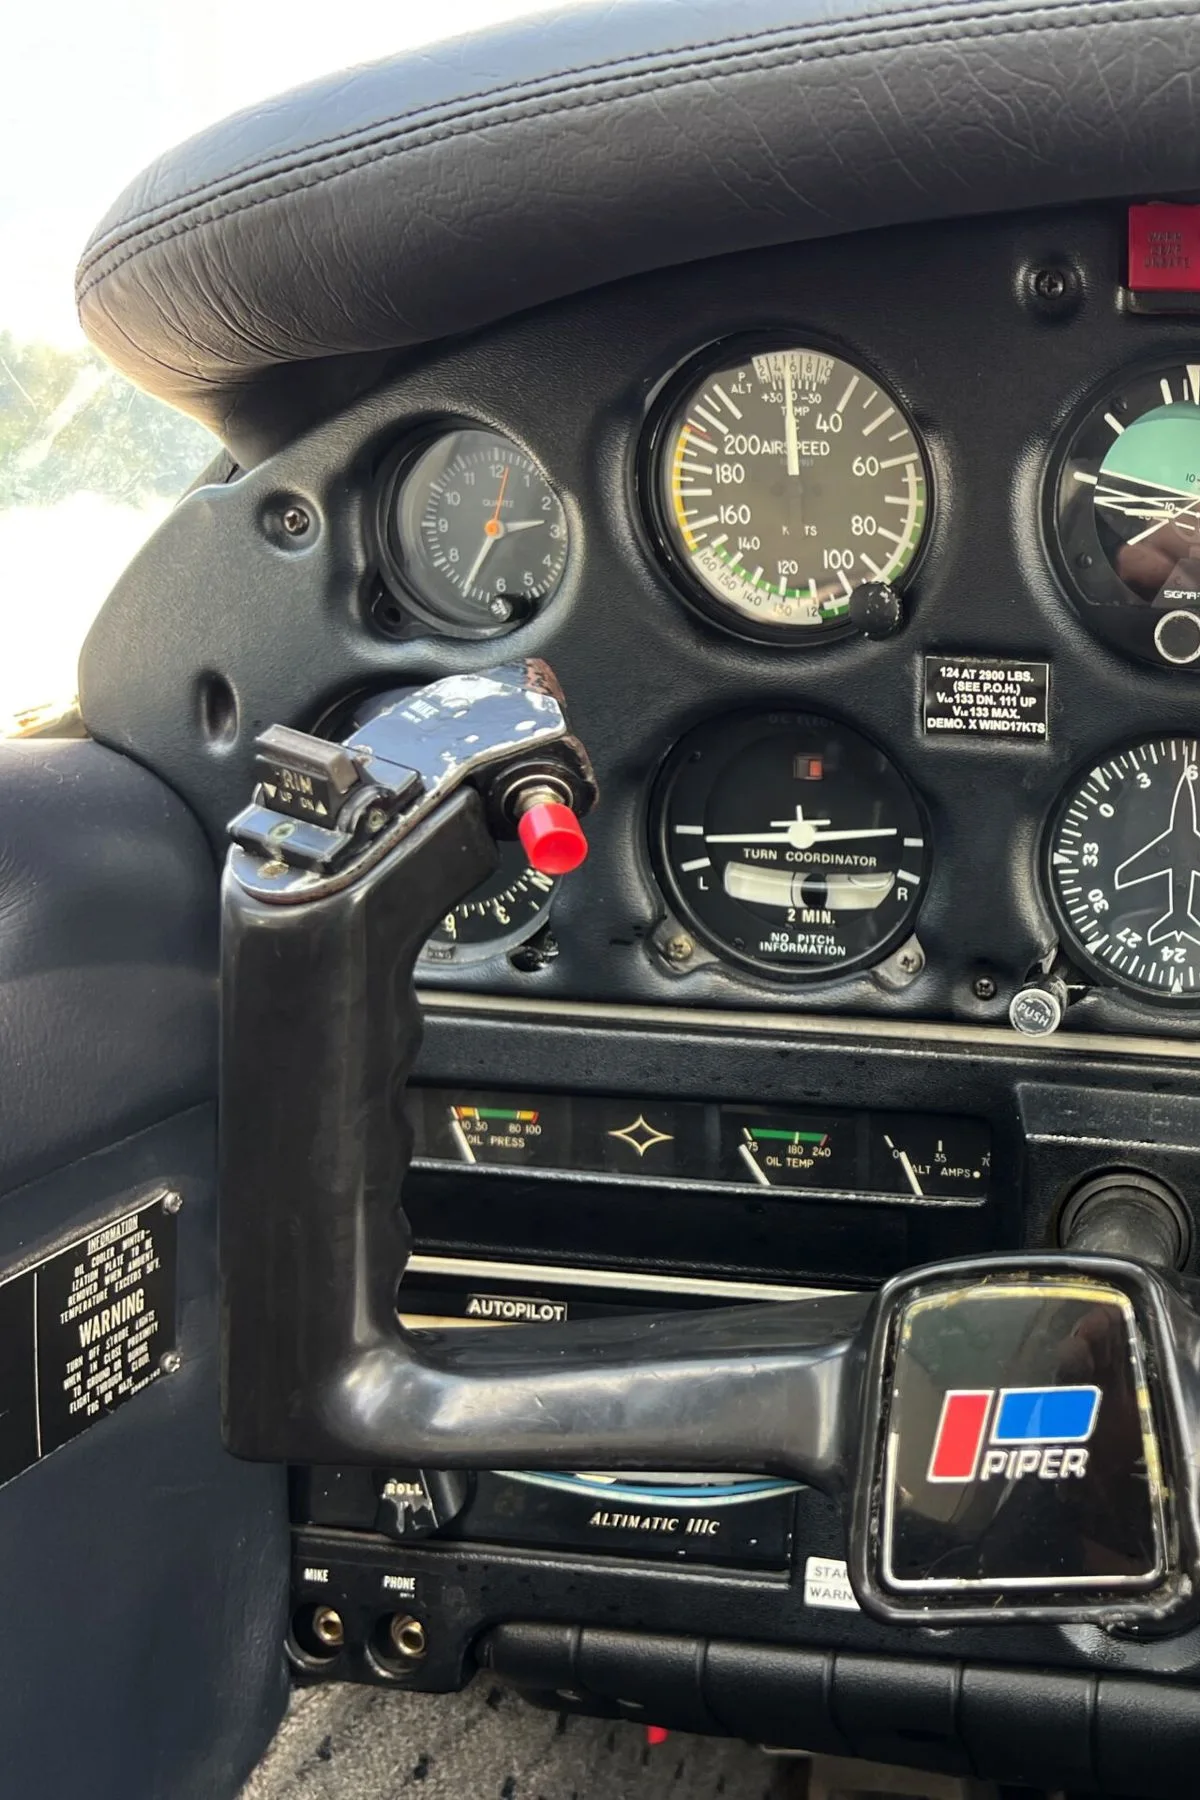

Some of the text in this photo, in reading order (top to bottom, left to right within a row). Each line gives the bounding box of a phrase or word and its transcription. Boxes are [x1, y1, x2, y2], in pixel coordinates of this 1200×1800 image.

[731, 384, 752, 393] ALT
[816, 414, 842, 433] 40
[724, 435, 761, 455] 200
[715, 464, 745, 484] 180
[853, 457, 879, 476] 60
[720, 505, 750, 524] 160
[851, 516, 877, 535] 80
[738, 536, 760, 550] 140
[824, 550, 854, 569] 100
[778, 561, 798, 575] 120
[940, 667, 1034, 682] 124 AT 2900 LBS.
[953, 681, 1021, 696] (SEE P.O.H.)
[954, 694, 1036, 707] 133 DN. 111 UP
[970, 707, 1020, 719] 133 MAX.
[927, 718, 966, 729] DEMO.
[969, 719, 977, 729] X
[744, 848, 877, 867] TURN COORDINATOR
[700, 876, 708, 891] L
[897, 887, 908, 900] R
[788, 910, 836, 924] 2 MIN.
[771, 932, 835, 945] NO PITCH
[760, 941, 846, 956] INFORMATION
[1016, 1001, 1050, 1027] PUSH
[467, 1135, 525, 1148] OIL PRESS
[788, 1145, 831, 1157] 180 240
[934, 1153, 947, 1163] 35
[766, 1157, 814, 1169] OIL TEMP
[941, 1167, 971, 1178] AMPS
[87, 1214, 138, 1256] INFORMATION
[60, 1287, 109, 1324] TEMPERATURE
[469, 1299, 565, 1321] AUTOPILOT
[79, 1288, 145, 1348] WARNING
[980, 1448, 1089, 1481] PIPER
[386, 1482, 423, 1495] ROLL
[590, 1512, 720, 1534] ALTIMATIC IIIC
[304, 1568, 328, 1582] MIKE
[384, 1575, 415, 1590] PHONE
